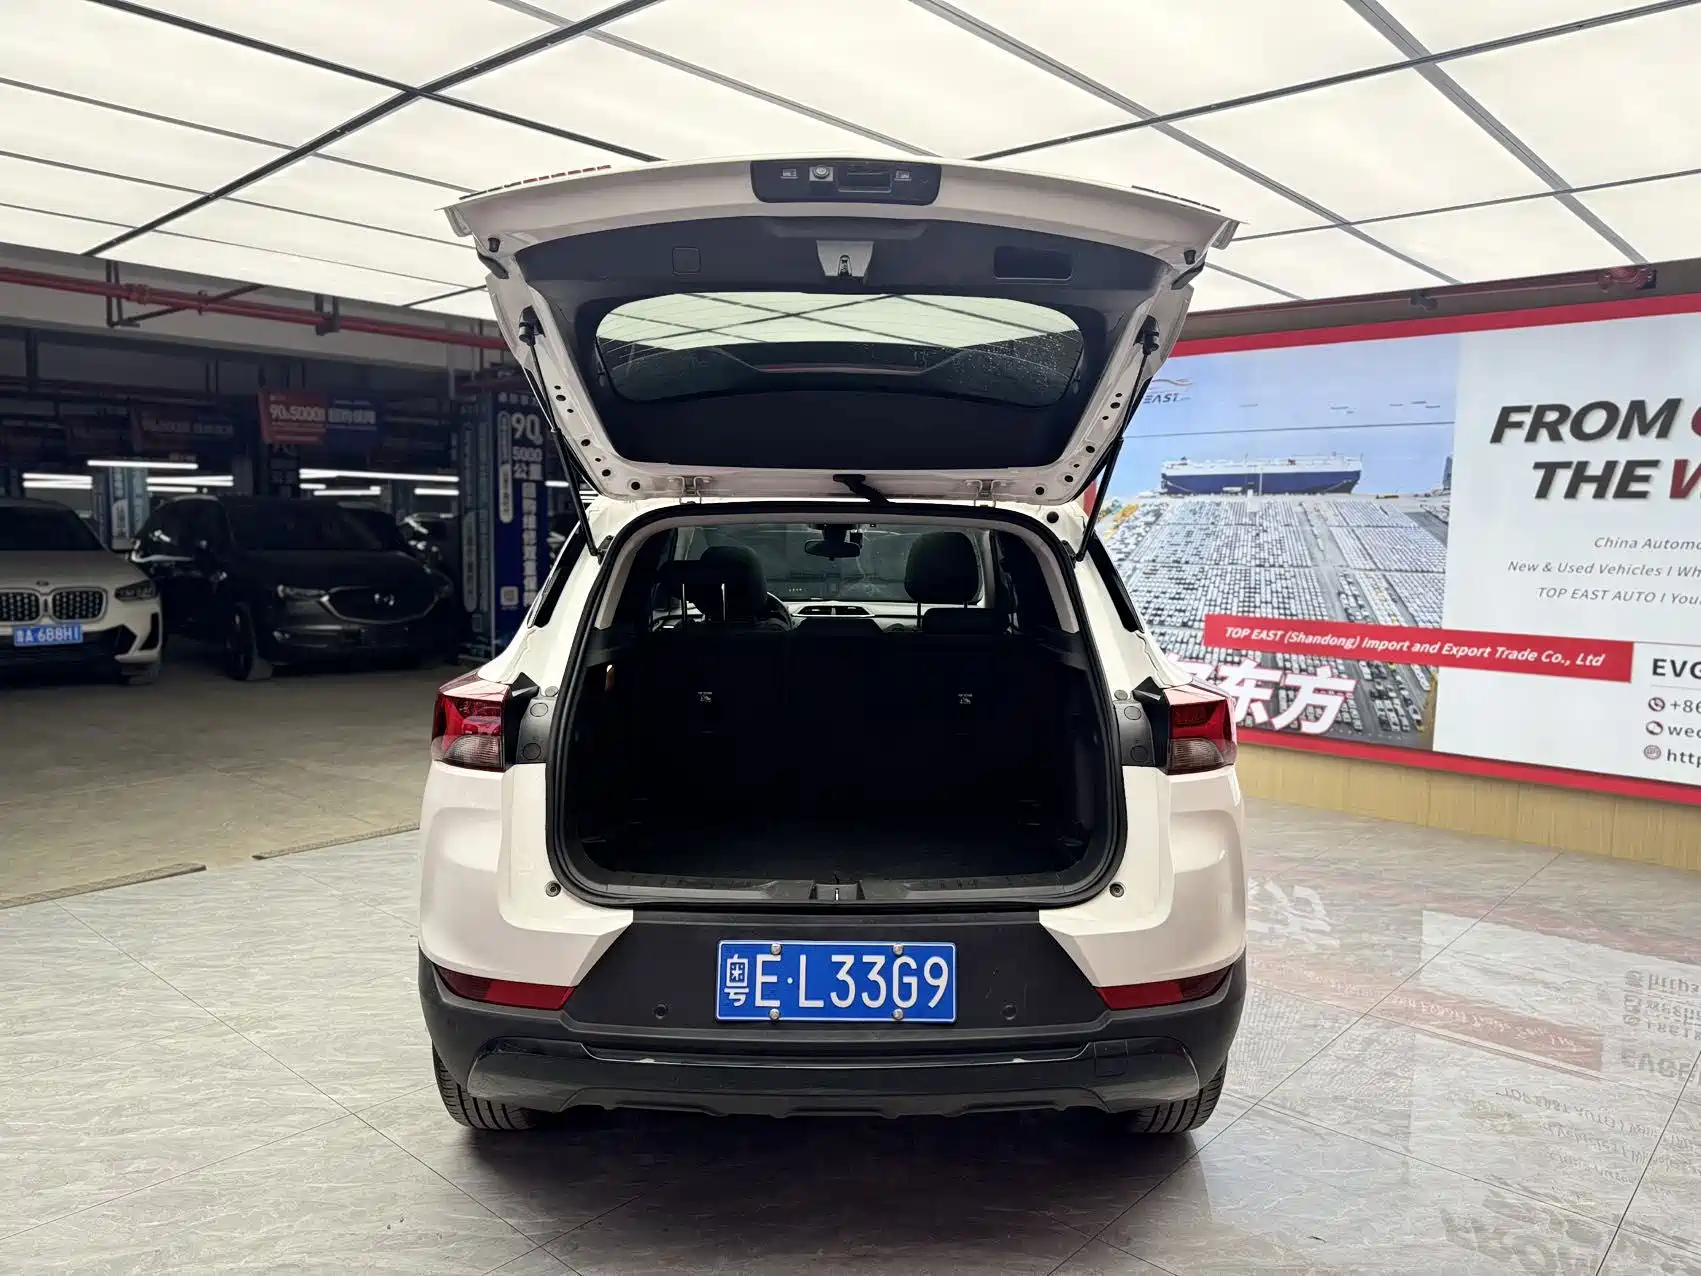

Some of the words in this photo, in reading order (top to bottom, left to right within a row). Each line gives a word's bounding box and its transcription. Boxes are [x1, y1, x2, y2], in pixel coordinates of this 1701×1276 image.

[1490, 398, 1682, 444] FROM
[1533, 459, 1661, 499] THE
[1594, 537, 1638, 549] China
[1508, 561, 1539, 572] New
[1542, 562, 1552, 572] &
[1557, 562, 1595, 574] Used
[1599, 563, 1662, 576] Vehicles
[1538, 587, 1567, 598] TOP
[1571, 588, 1609, 601] EAST
[1612, 591, 1656, 603] AUTO
[1671, 593, 1701, 605] You
[1225, 627, 1250, 638] TOP
[1251, 629, 1284, 641] EAST
[1284, 631, 1360, 649] (Shandong)
[1362, 638, 1410, 652] Import
[1411, 641, 1441, 654] and
[1441, 643, 1491, 659] Export
[1495, 646, 1537, 661] Trade
[1541, 650, 1570, 666] Co.,
[1576, 653, 1606, 667] Ltd
